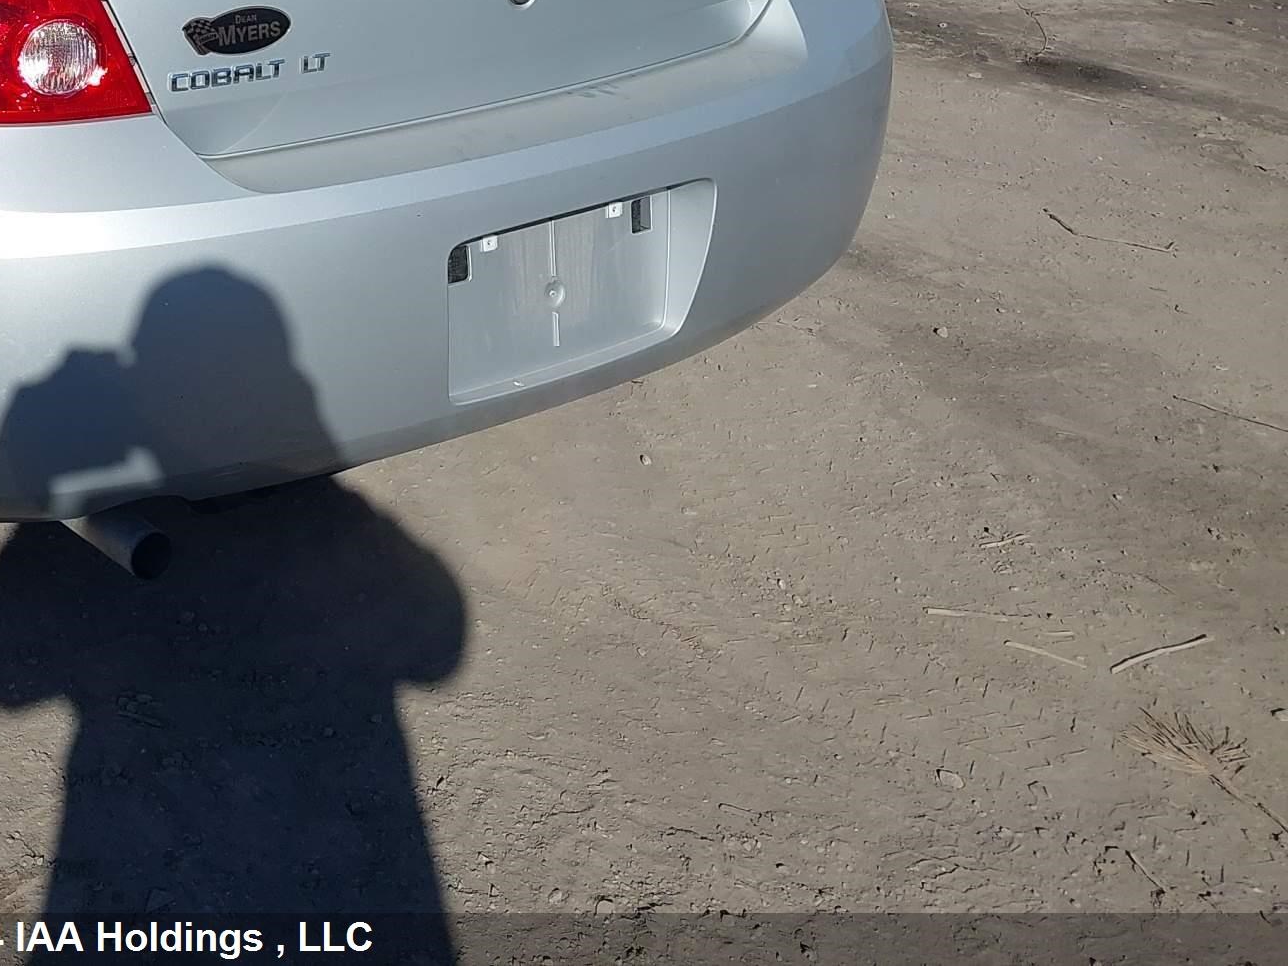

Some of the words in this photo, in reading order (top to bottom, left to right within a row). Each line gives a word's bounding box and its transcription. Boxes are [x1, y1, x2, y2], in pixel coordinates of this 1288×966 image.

[217, 21, 281, 47] MYERS
[169, 59, 286, 93] COBALT
[300, 52, 332, 75] LT
